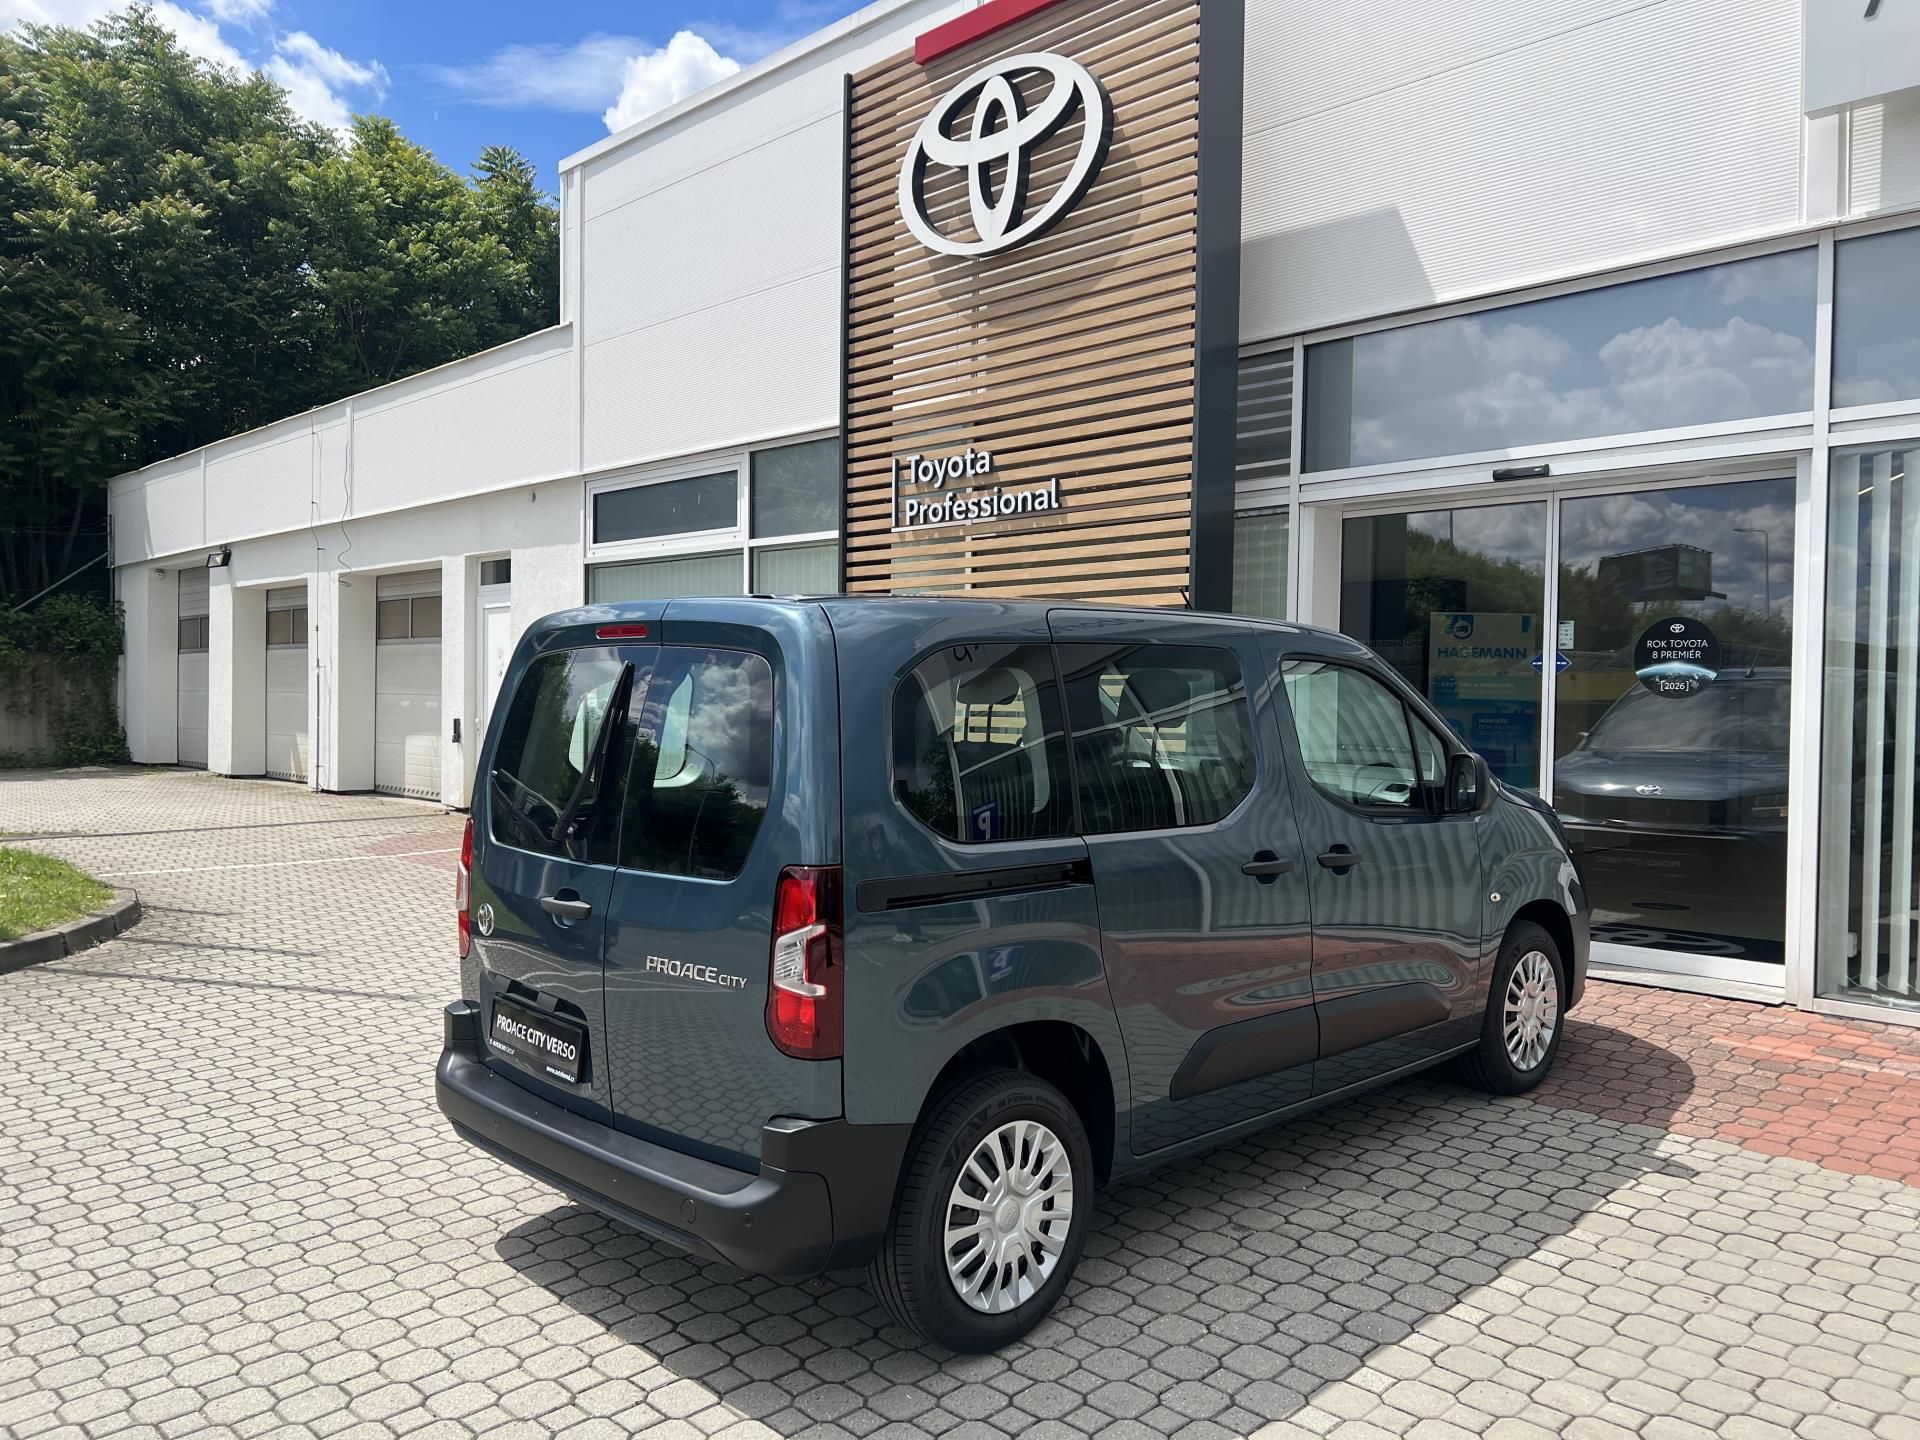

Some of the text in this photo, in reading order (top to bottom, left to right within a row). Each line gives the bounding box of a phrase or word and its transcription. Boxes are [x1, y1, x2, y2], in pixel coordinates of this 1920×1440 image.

[906, 448, 991, 488] Toyota
[905, 477, 1059, 526] Professional
[1437, 647, 1527, 659] HAGEMANN
[1647, 640, 1709, 648] ROK TOYOTA
[1652, 649, 1702, 659] 8 PREMIÉR
[646, 955, 748, 989] PROACE CITY
[496, 1014, 576, 1060] PROACE CITY VERSO
